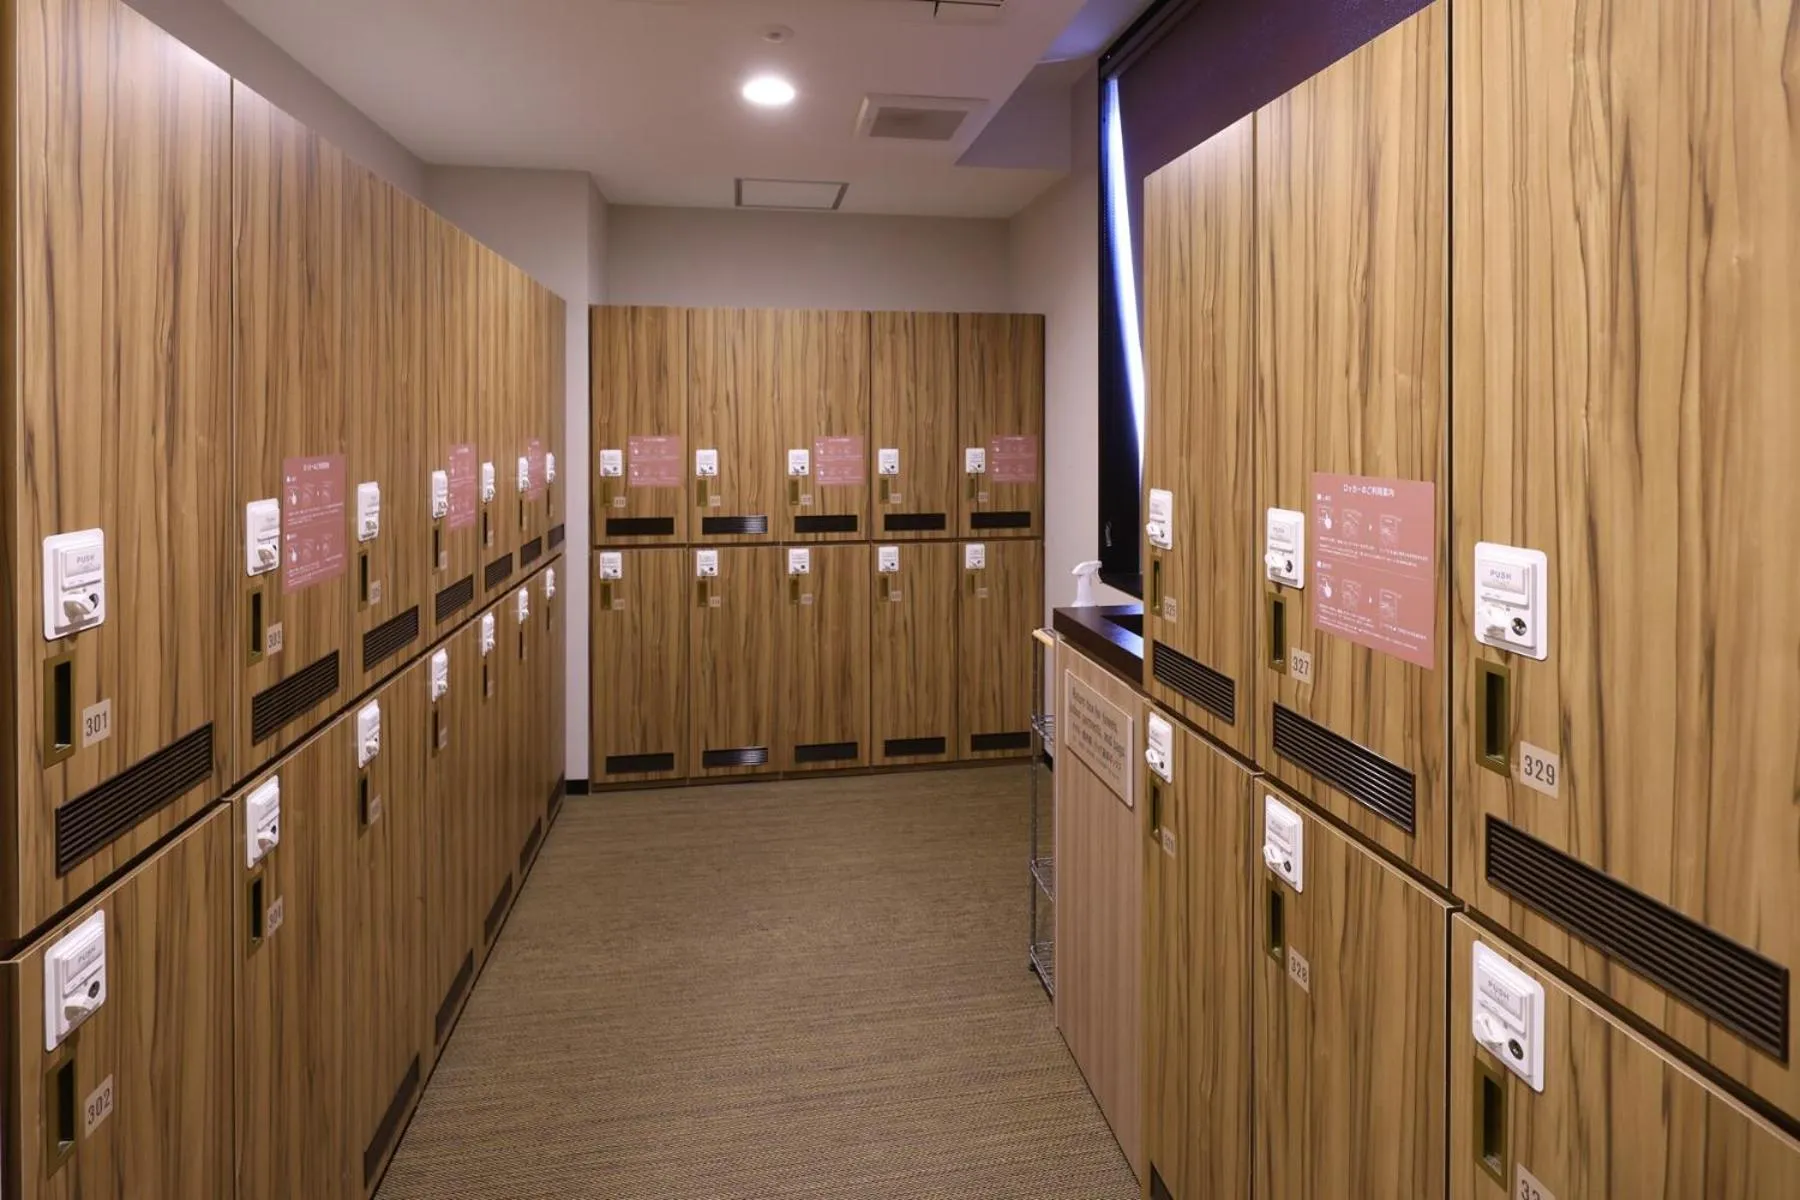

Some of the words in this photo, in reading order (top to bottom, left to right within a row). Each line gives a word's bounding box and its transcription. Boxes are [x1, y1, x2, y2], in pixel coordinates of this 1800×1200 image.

[1489, 569, 1512, 581] PUSH
[1293, 656, 1309, 675] 327
[86, 710, 107, 737] 301
[1524, 755, 1555, 786] 329
[88, 1088, 110, 1125] 302
